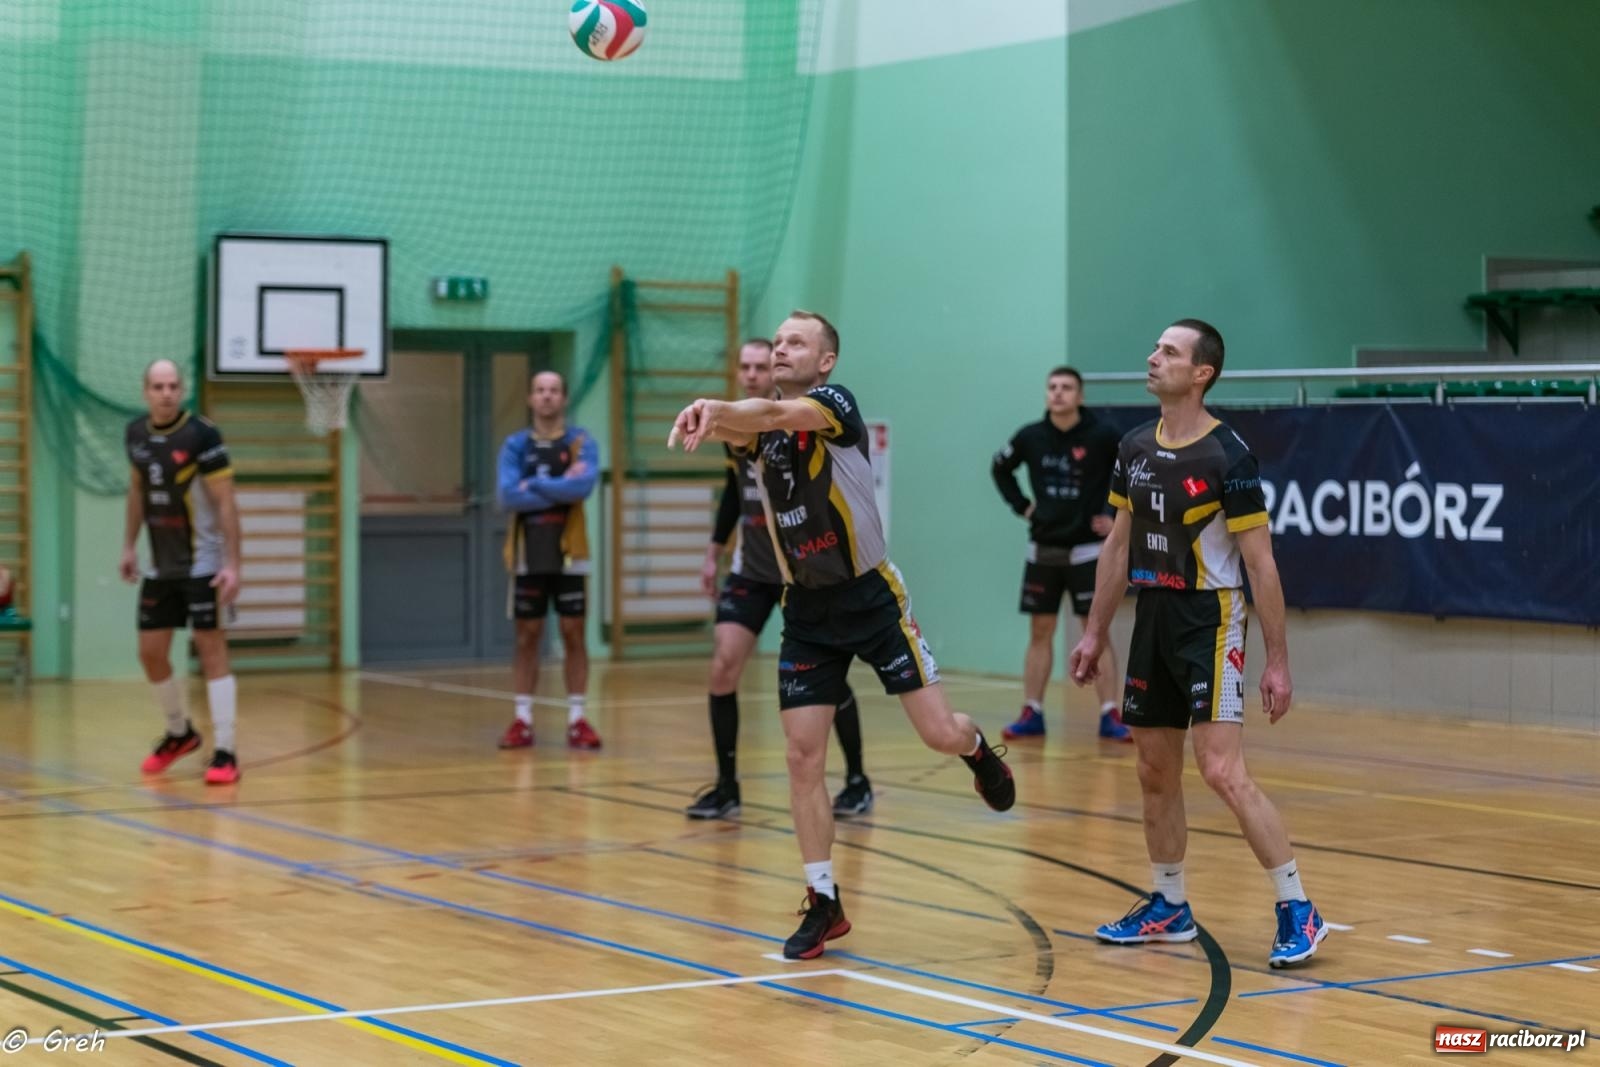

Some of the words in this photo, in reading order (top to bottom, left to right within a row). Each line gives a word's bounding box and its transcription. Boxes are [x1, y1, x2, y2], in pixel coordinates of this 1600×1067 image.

[782, 471, 795, 500] 7
[776, 505, 808, 528] ENTER
[1151, 491, 1165, 523] 4
